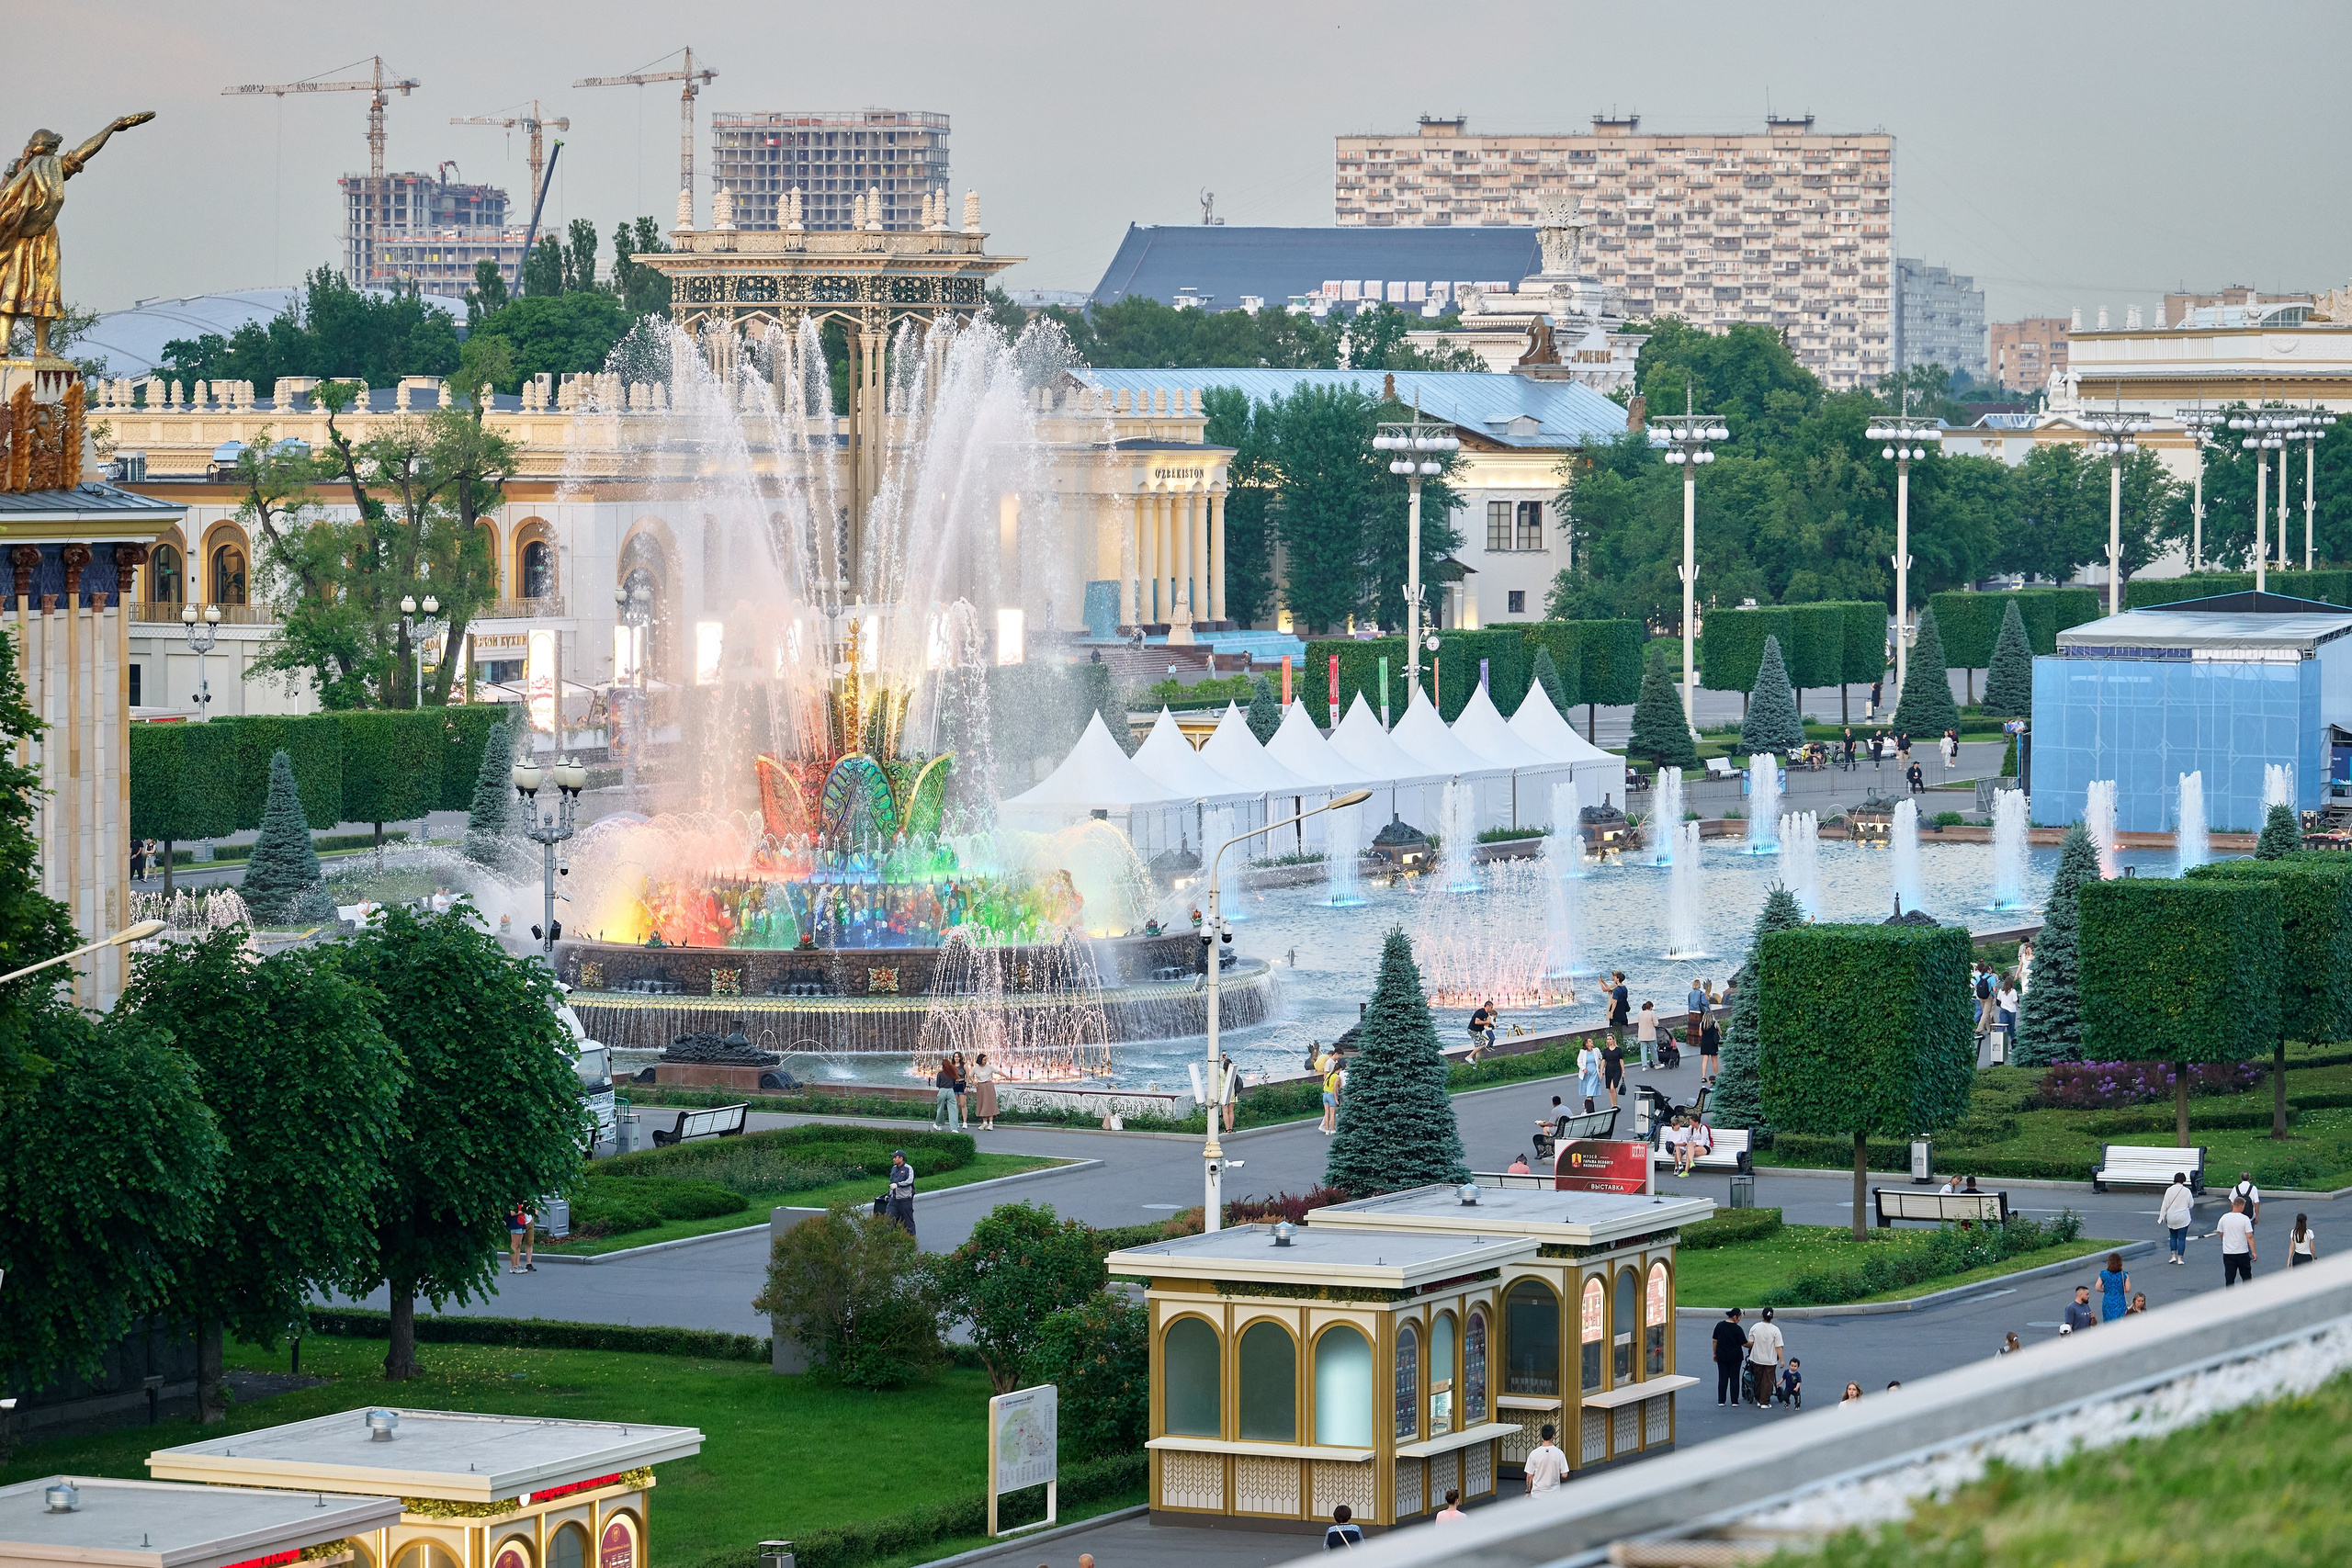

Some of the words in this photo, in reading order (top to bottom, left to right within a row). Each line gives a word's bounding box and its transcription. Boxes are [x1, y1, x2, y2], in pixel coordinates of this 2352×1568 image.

[1571, 349, 1611, 364] АРМЕНИЯ
[1023, 1097, 1048, 1109] ВДНХ
[1113, 1102, 1140, 1112] ВДНХ
